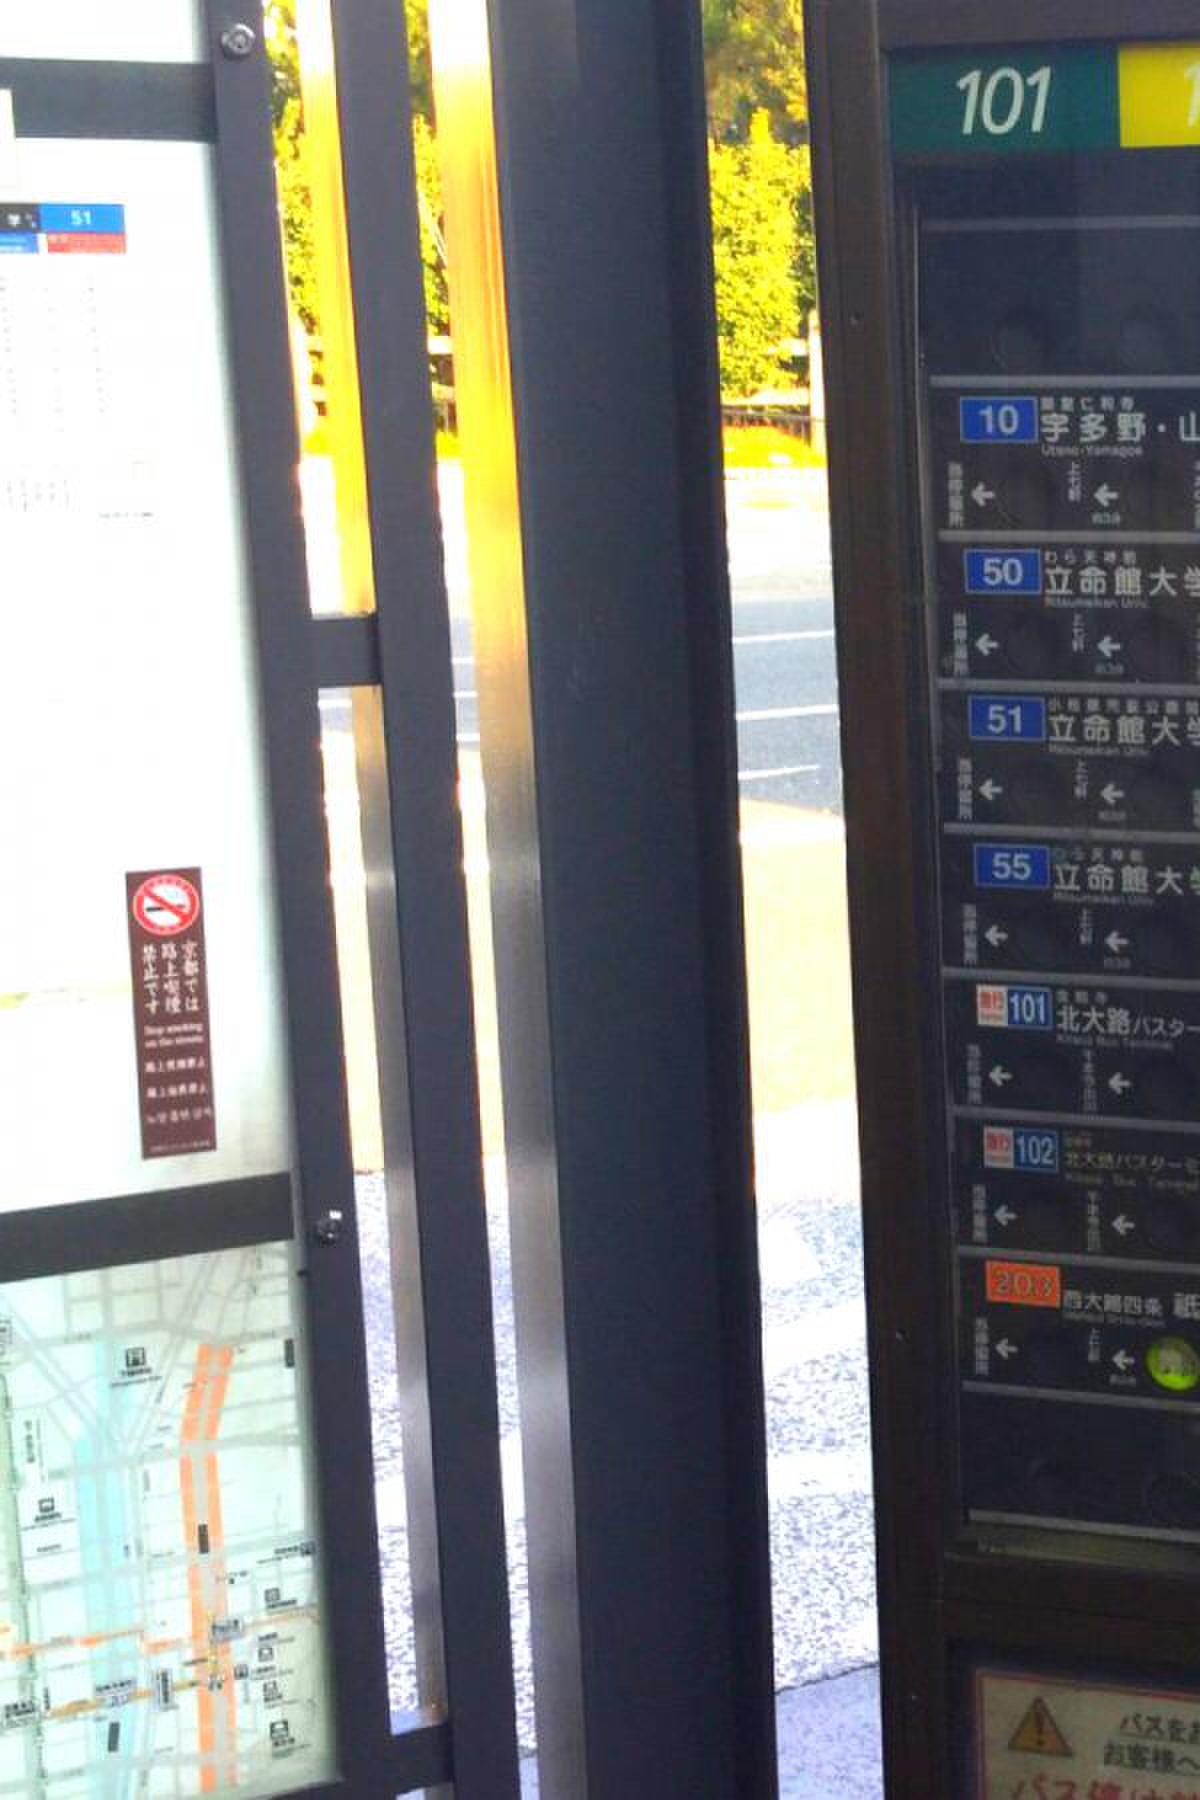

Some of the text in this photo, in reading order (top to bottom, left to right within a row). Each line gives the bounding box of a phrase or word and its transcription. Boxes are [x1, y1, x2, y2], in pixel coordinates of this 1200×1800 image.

[957, 66, 1052, 135] 101
[71, 209, 92, 225] 51
[979, 405, 1019, 435] 10
[983, 557, 1024, 587] 50
[987, 706, 1025, 735] 51
[992, 852, 1031, 881] 55
[1009, 992, 1046, 1025] 101
[1016, 1135, 1054, 1165] 102
